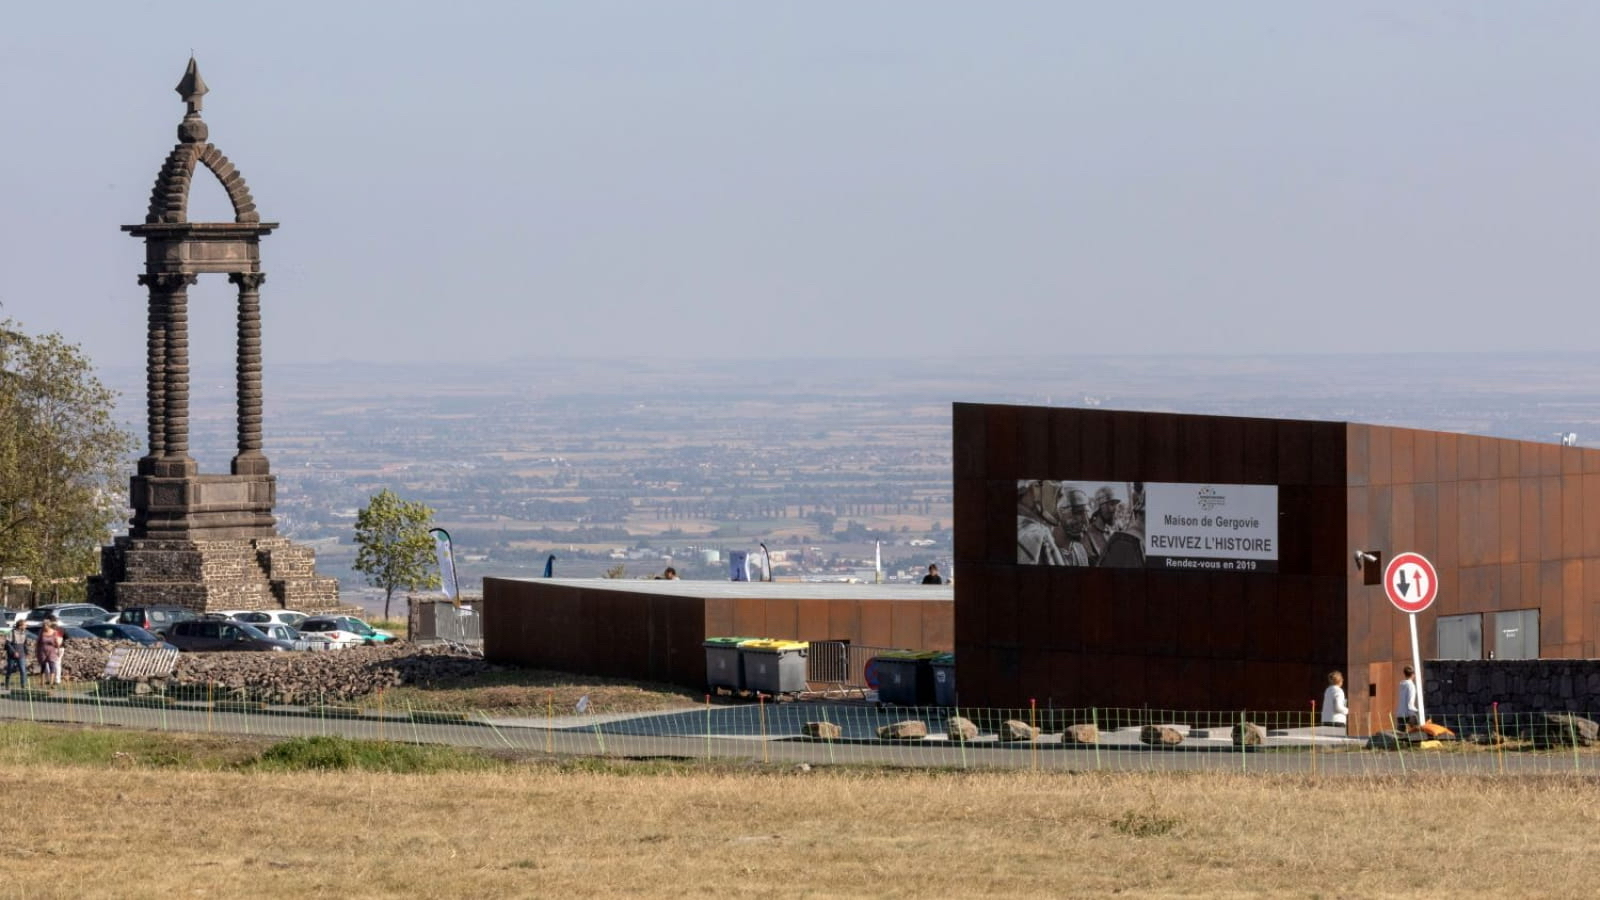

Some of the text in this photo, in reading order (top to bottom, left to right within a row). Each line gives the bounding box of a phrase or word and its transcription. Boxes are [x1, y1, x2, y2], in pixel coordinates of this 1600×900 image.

[1164, 514, 1259, 530] Maison de Gergovie
[1151, 535, 1272, 552] REVIVEZ L'HISTOIRE
[1166, 558, 1256, 570] Rendez-vous en 2019
